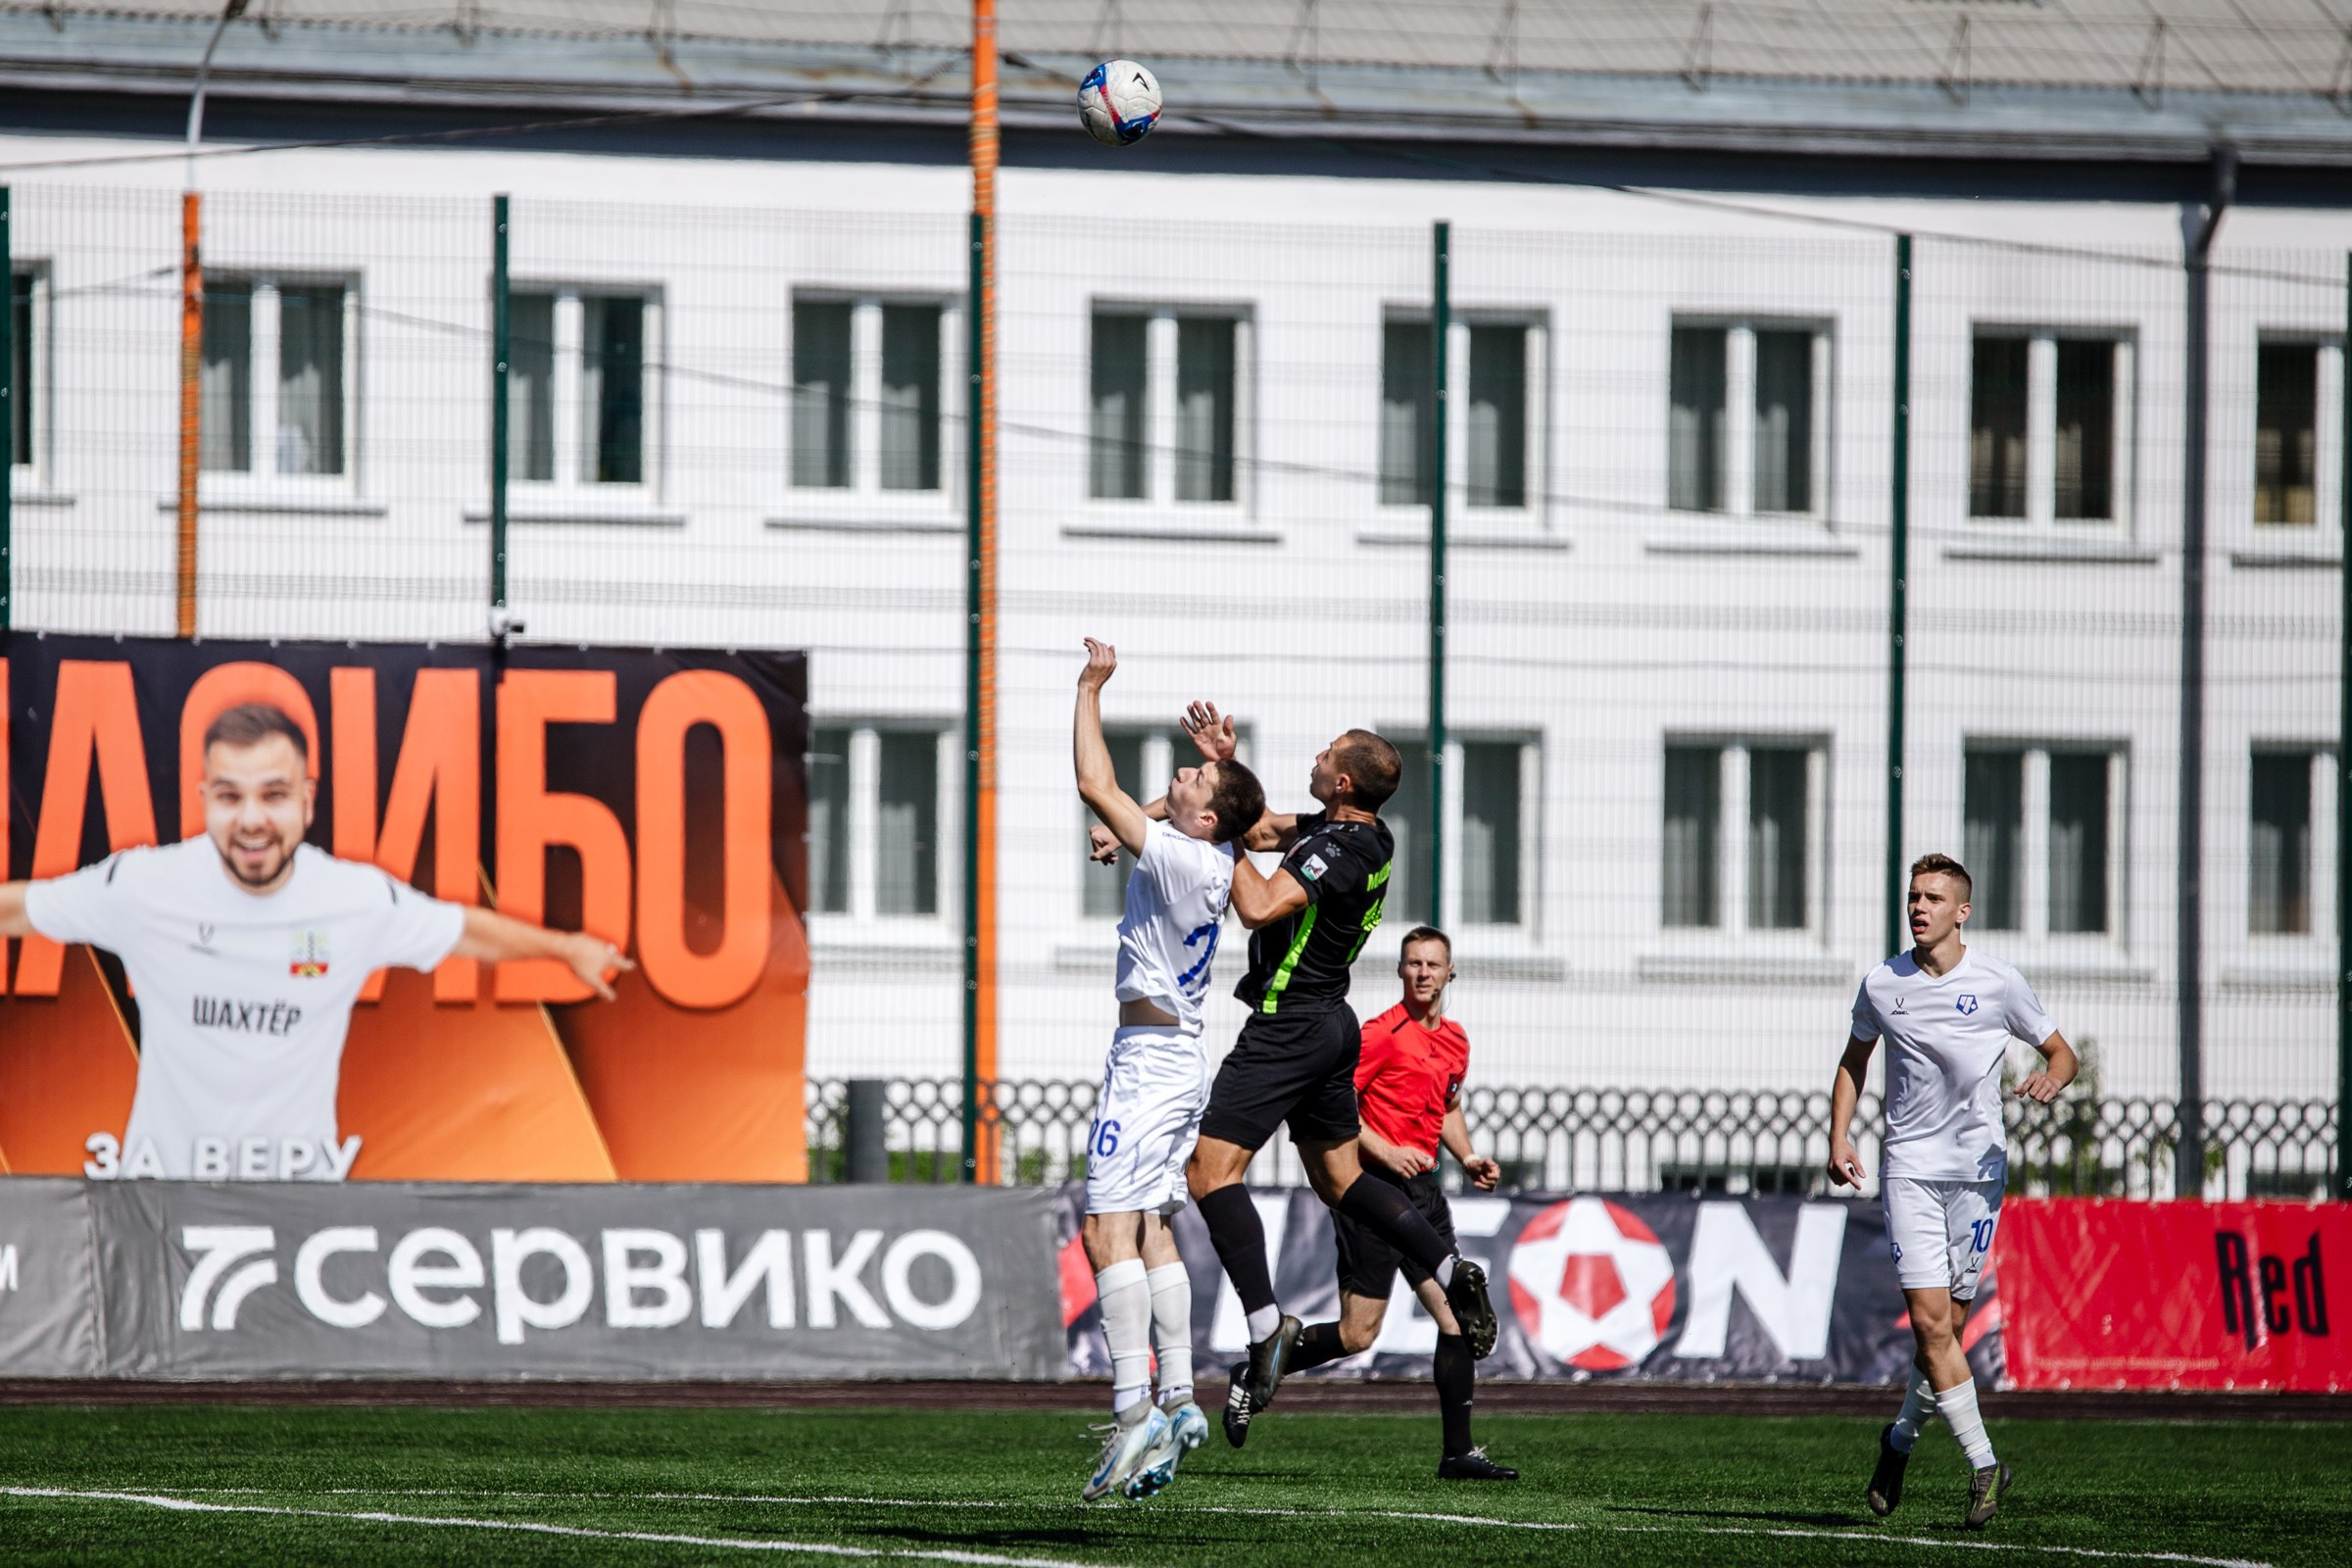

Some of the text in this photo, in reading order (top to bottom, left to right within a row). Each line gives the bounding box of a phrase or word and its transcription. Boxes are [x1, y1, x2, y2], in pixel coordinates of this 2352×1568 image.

[0, 657, 772, 1007] АСИБО
[193, 995, 302, 1036] ШАХТЁР
[83, 1132, 363, 1182] ЗА ВЕРУ
[1969, 1218, 1994, 1253] 10
[2215, 1229, 2329, 1353] Red
